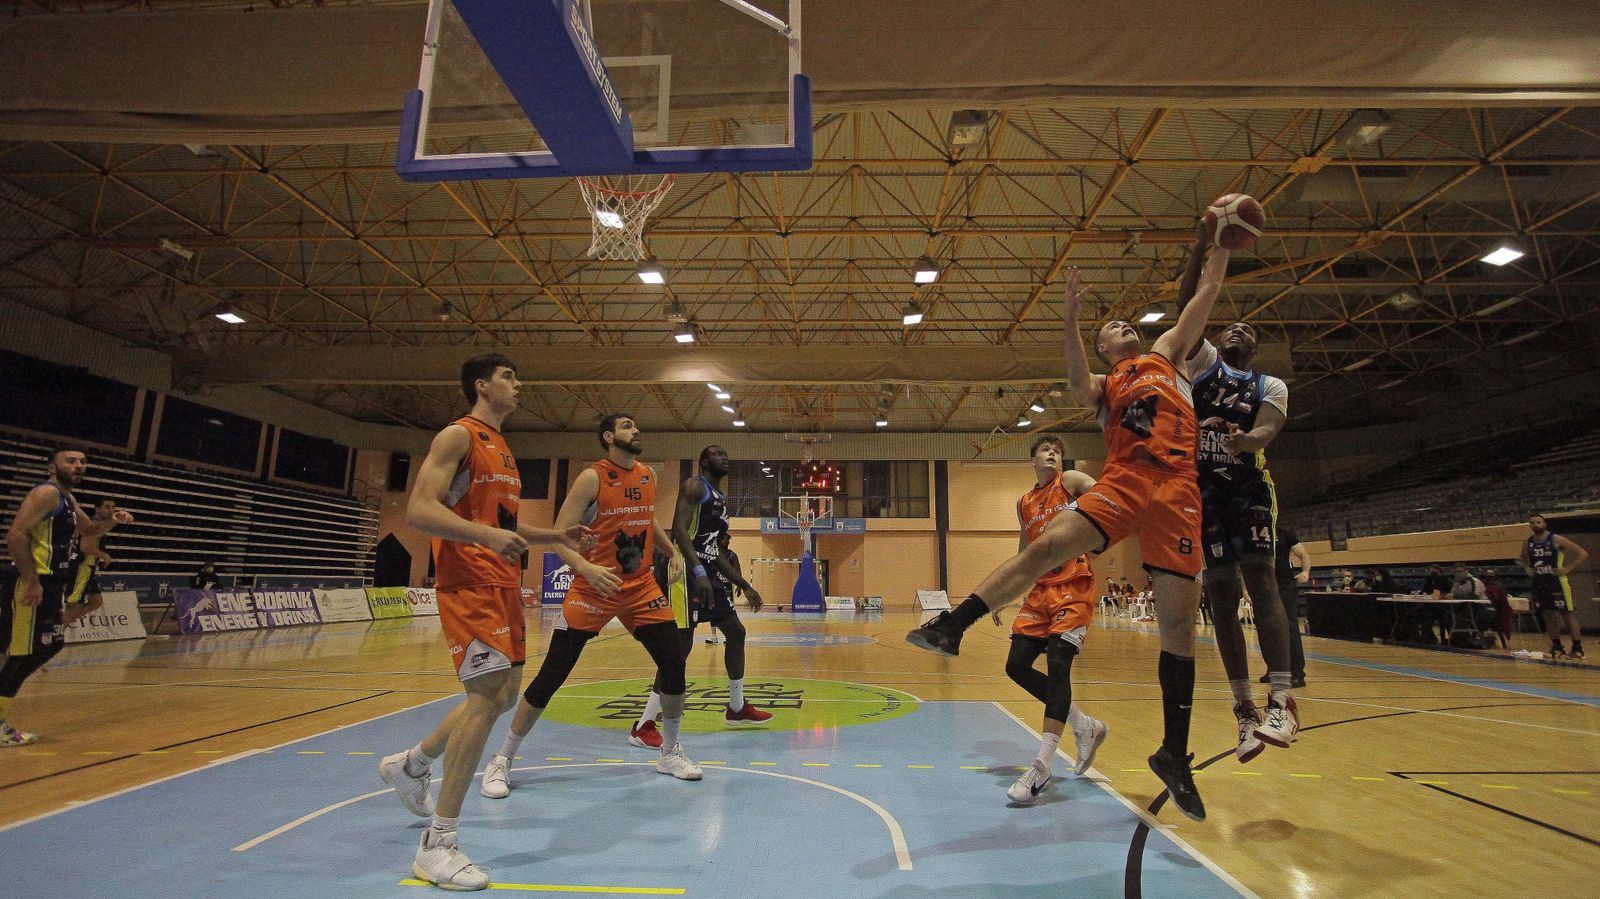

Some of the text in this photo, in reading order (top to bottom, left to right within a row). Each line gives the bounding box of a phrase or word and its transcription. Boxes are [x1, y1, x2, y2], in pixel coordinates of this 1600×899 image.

[596, 60, 622, 120] SYSTEM
[1200, 429, 1230, 442] ENE
[1212, 453, 1245, 465] DRINK
[624, 487, 642, 501] 45
[600, 505, 648, 515] JUARISTI
[1250, 526, 1272, 542] 14
[1178, 537, 1193, 555] 8
[1533, 549, 1544, 557] 33
[648, 595, 670, 610] 45
[271, 609, 321, 626] DRINK
[1056, 608, 1067, 622] 2
[80, 631, 110, 639] HOTELS
